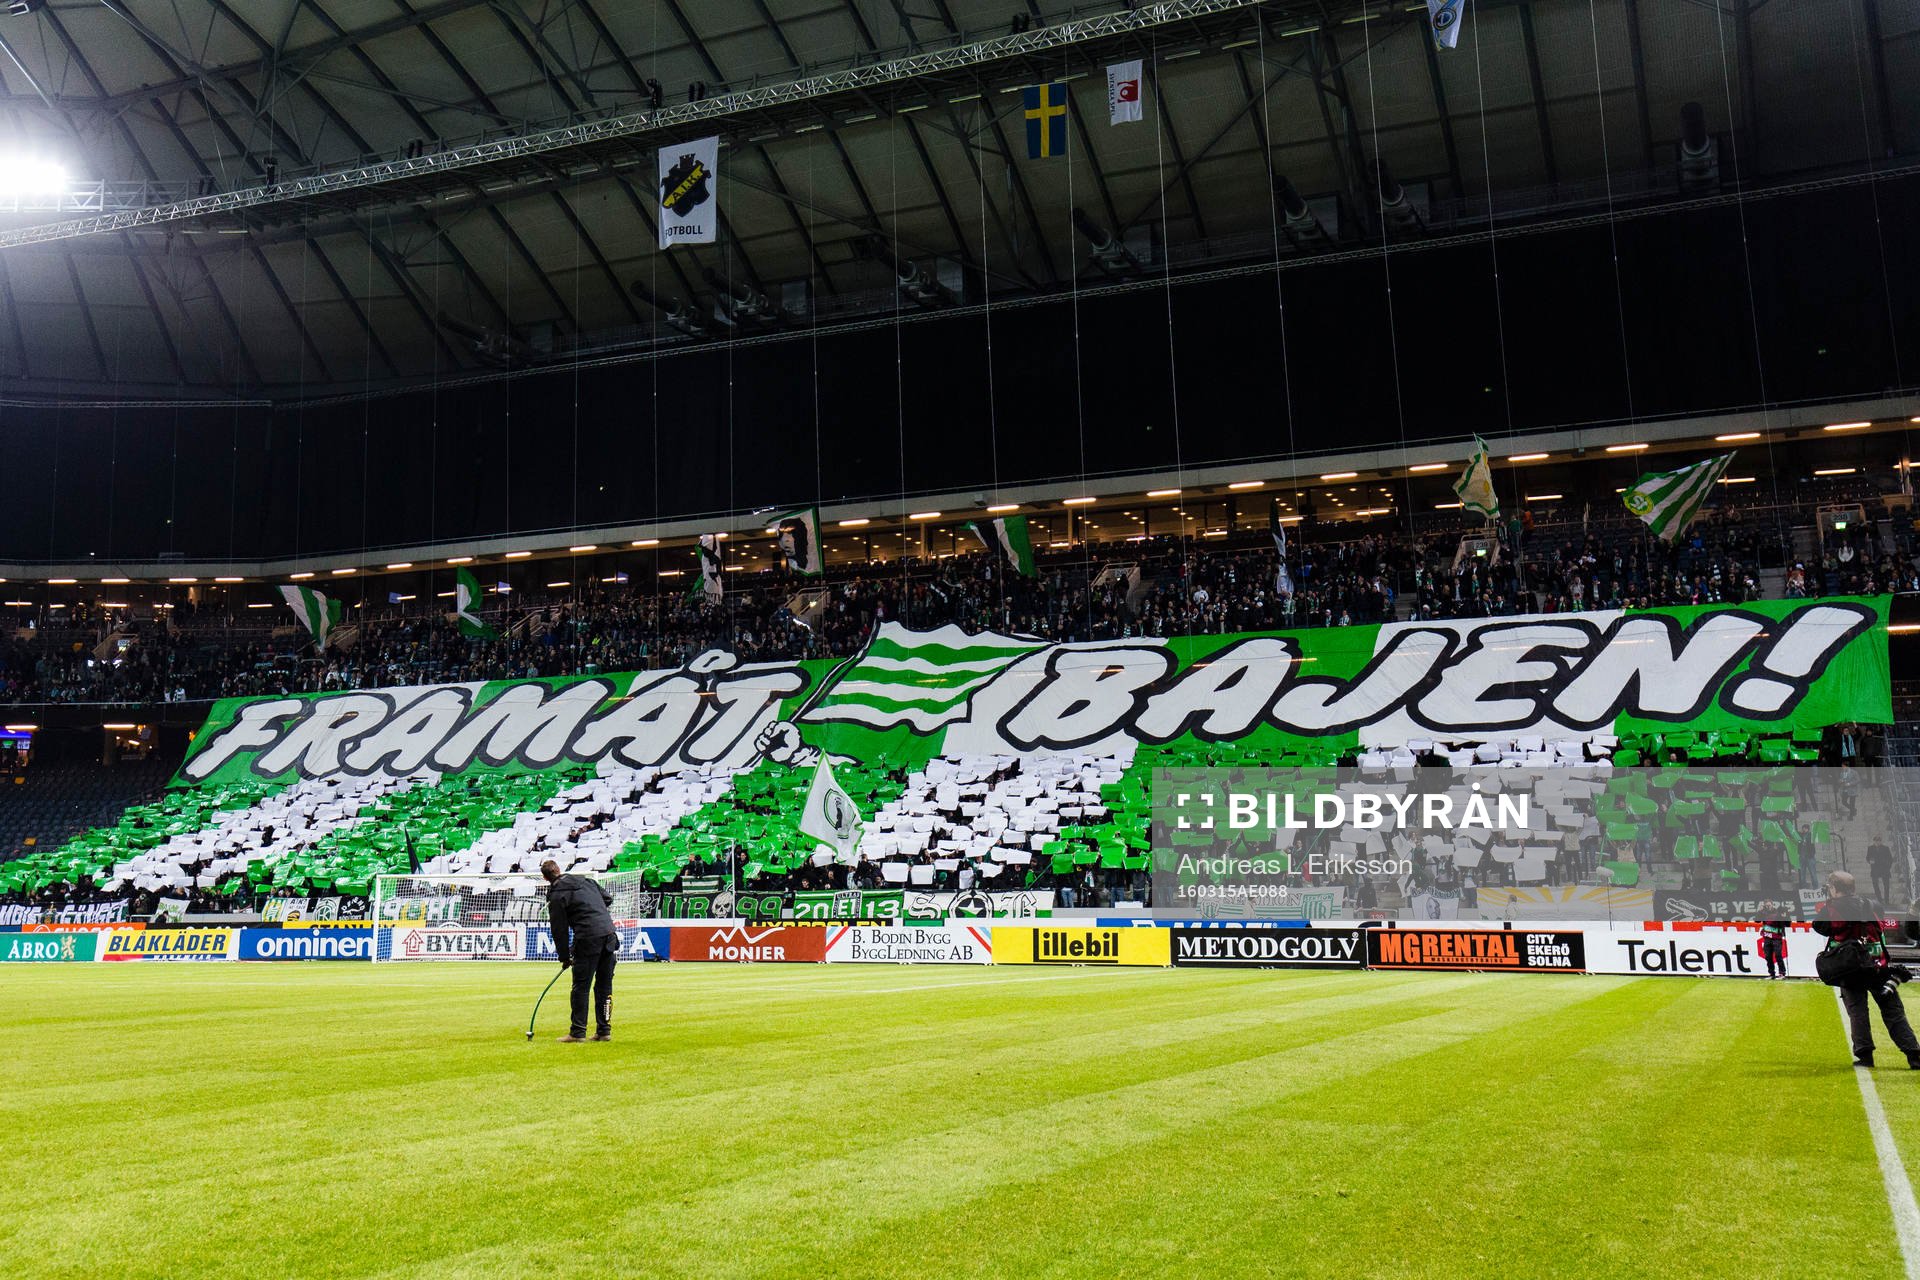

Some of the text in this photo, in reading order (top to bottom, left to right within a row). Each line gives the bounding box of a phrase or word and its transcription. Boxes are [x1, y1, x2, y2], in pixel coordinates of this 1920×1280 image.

[996, 600, 1878, 751] BAJEN!
[181, 649, 809, 785] FRAMÅT
[796, 900, 899, 918] 20 13
[1710, 902, 1728, 914] 12
[108, 931, 226, 952] BLÅKLÄDER
[256, 929, 373, 957] onninen
[426, 934, 511, 952] BYGMA
[852, 929, 866, 943] B.
[1526, 934, 1555, 944] CITY
[8, 939, 59, 959] ÅBRO
[709, 946, 785, 960] MONIER
[949, 945, 973, 960] AB
[1177, 936, 1358, 959] METODGOLV
[1527, 944, 1570, 956] EKERÖ
[1618, 939, 1751, 973] Talent
[1527, 956, 1572, 967] SOLNA
